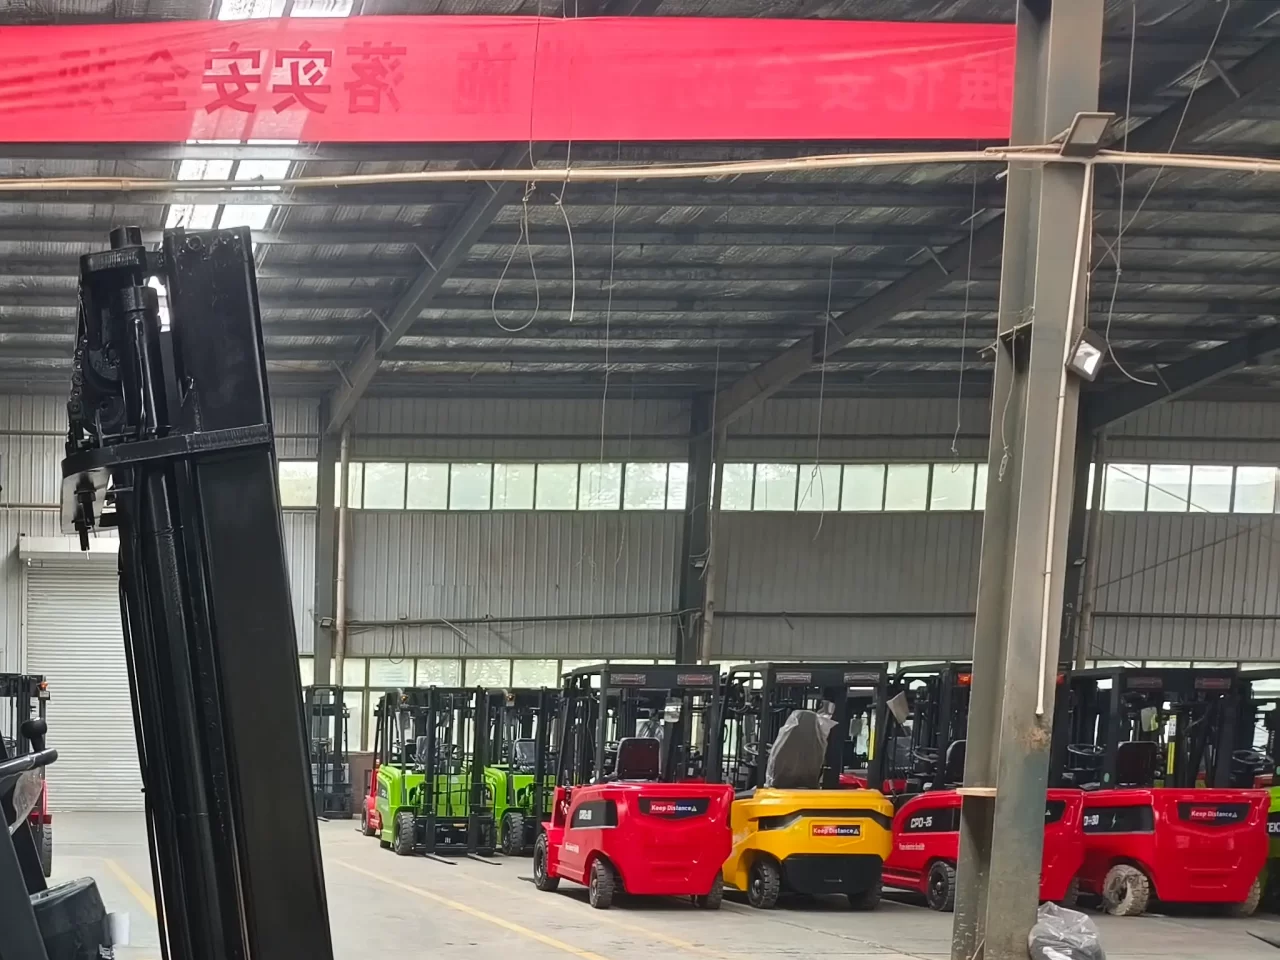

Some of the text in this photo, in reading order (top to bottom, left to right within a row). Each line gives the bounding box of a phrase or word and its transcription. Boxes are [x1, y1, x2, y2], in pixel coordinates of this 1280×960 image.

[651, 804, 667, 812] Keep
[1191, 810, 1208, 818] Keep
[1083, 814, 1100, 827] D-30
[813, 827, 828, 835] Keep
